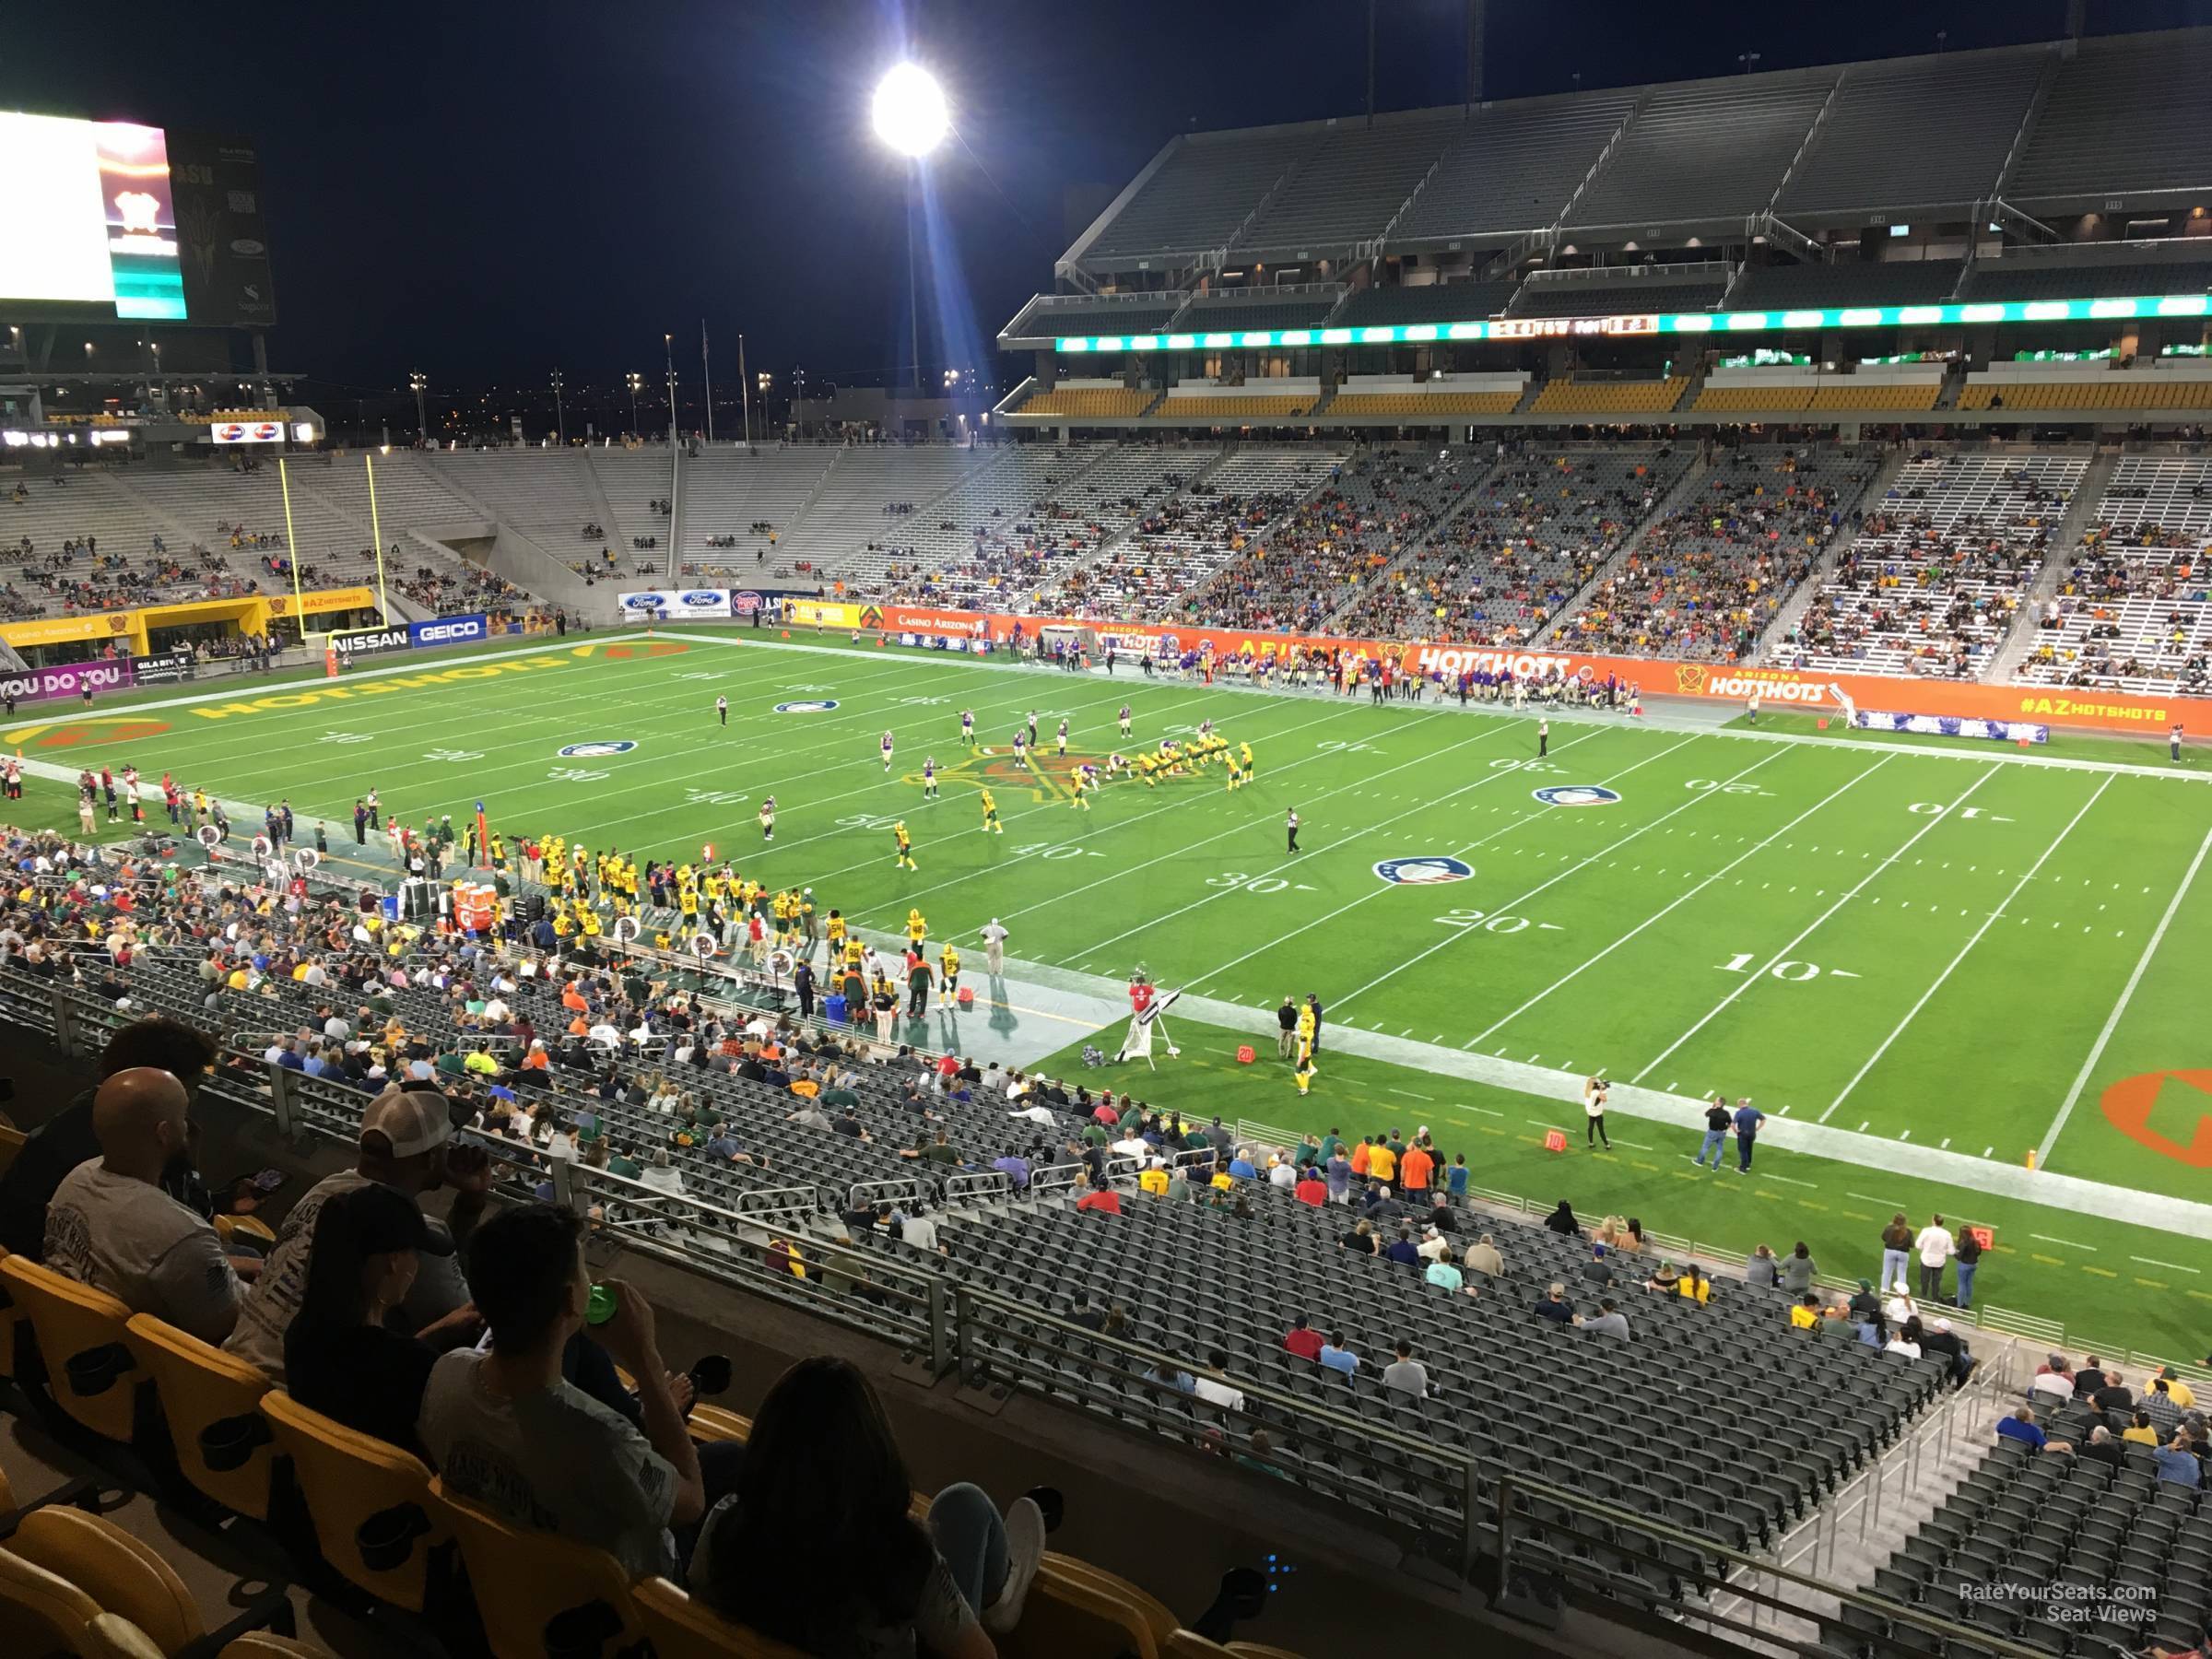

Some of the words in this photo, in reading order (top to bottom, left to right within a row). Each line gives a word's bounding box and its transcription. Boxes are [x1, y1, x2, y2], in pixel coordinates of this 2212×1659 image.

[633, 595, 658, 607] Ford
[689, 593, 714, 605] Ford
[419, 621, 479, 641] GEICO
[898, 614, 932, 628] CASINO
[934, 618, 974, 631] ARIZONA
[1102, 625, 1145, 634] ARIZONA
[333, 630, 407, 653] NISSAN
[137, 660, 159, 670] GILA
[159, 657, 186, 669] RIVR
[44, 673, 76, 692] DO
[1734, 670, 1800, 681] ARIZONA
[188, 656, 571, 719] HOTSHOTS
[1710, 677, 1826, 701] HOTSHOTS
[2020, 698, 2167, 721] #AZHOTSHOTS
[834, 814, 900, 830] 50
[1009, 842, 1084, 868] 40
[1206, 871, 1289, 893] 30
[1431, 909, 1530, 934] 20
[1713, 952, 1821, 981] 10
[1240, 1048, 1252, 1060] 20
[1549, 1134, 1560, 1148] 10
